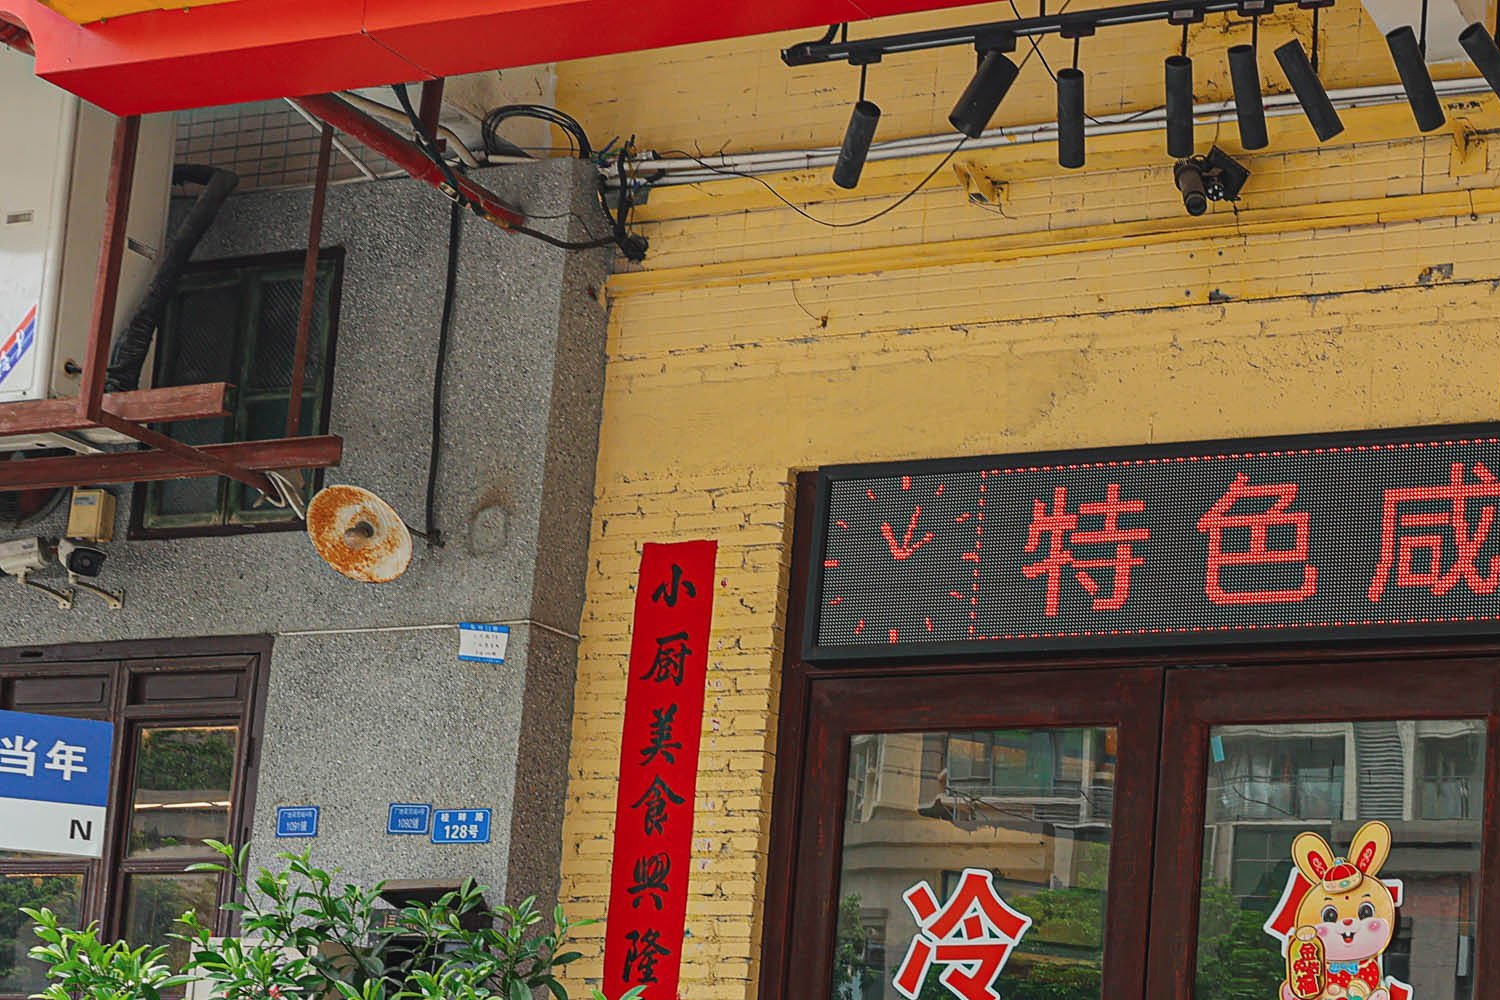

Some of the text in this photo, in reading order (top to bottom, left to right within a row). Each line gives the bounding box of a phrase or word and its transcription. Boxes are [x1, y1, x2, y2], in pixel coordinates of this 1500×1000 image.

[0, 735, 88, 781] 当年
[70, 819, 92, 840] N
[444, 824, 478, 839] 128号
